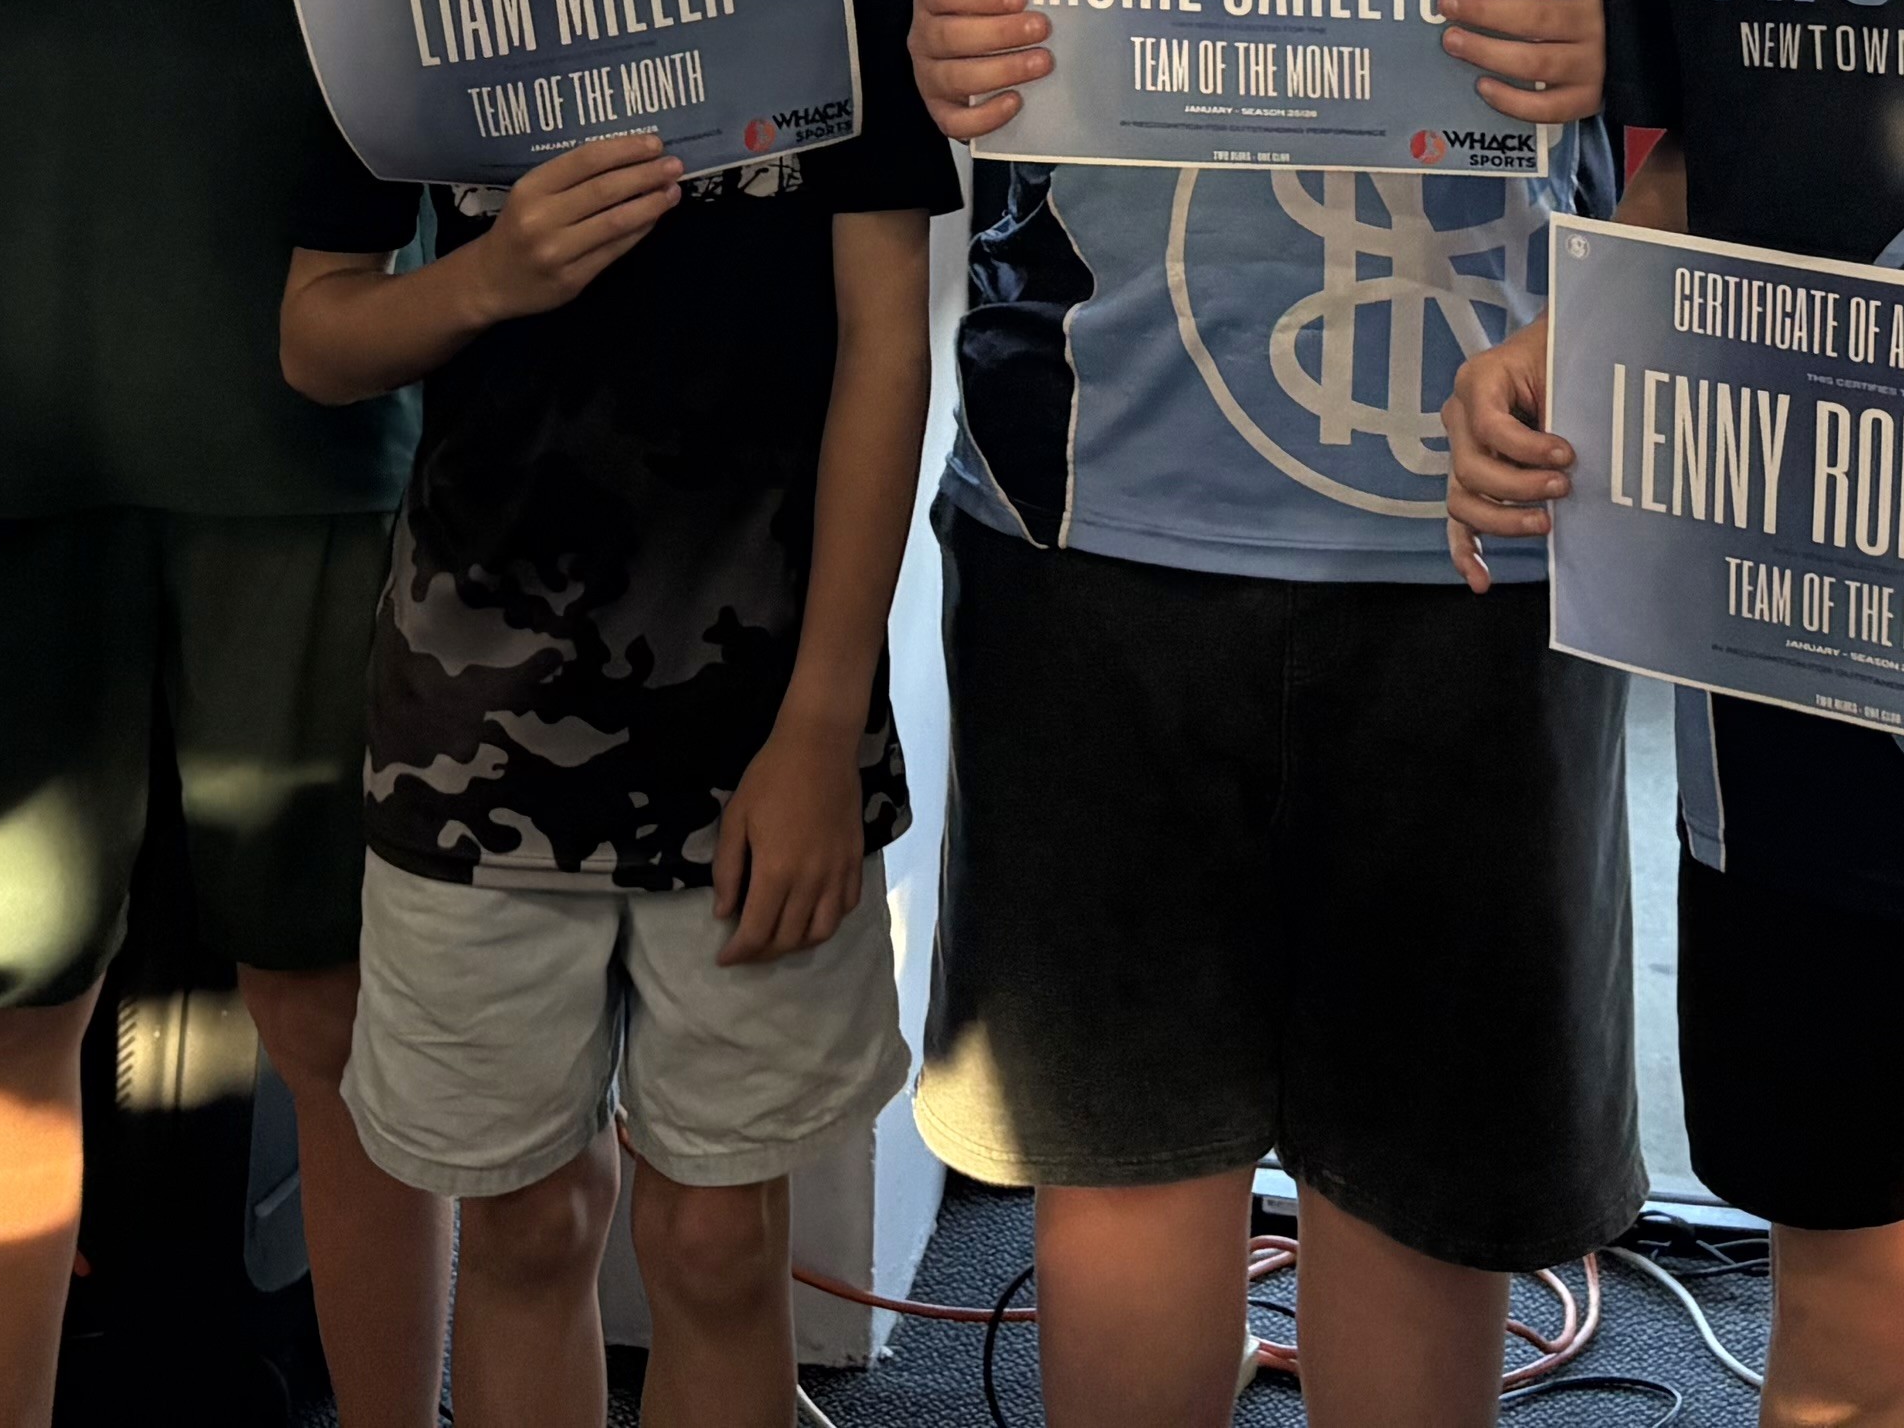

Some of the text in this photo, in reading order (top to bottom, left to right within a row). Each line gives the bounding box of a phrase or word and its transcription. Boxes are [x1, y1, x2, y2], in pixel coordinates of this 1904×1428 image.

[1443, 128, 1536, 154] WHACK
[1469, 152, 1538, 170] SPORTS
[1674, 266, 1839, 358] CERTIFICATE
[1848, 296, 1881, 364] OF
[1611, 363, 1791, 536] LENNY
[1725, 556, 1792, 627] TEAM
[1802, 572, 1837, 635] OF
[1844, 580, 1895, 647] THE
